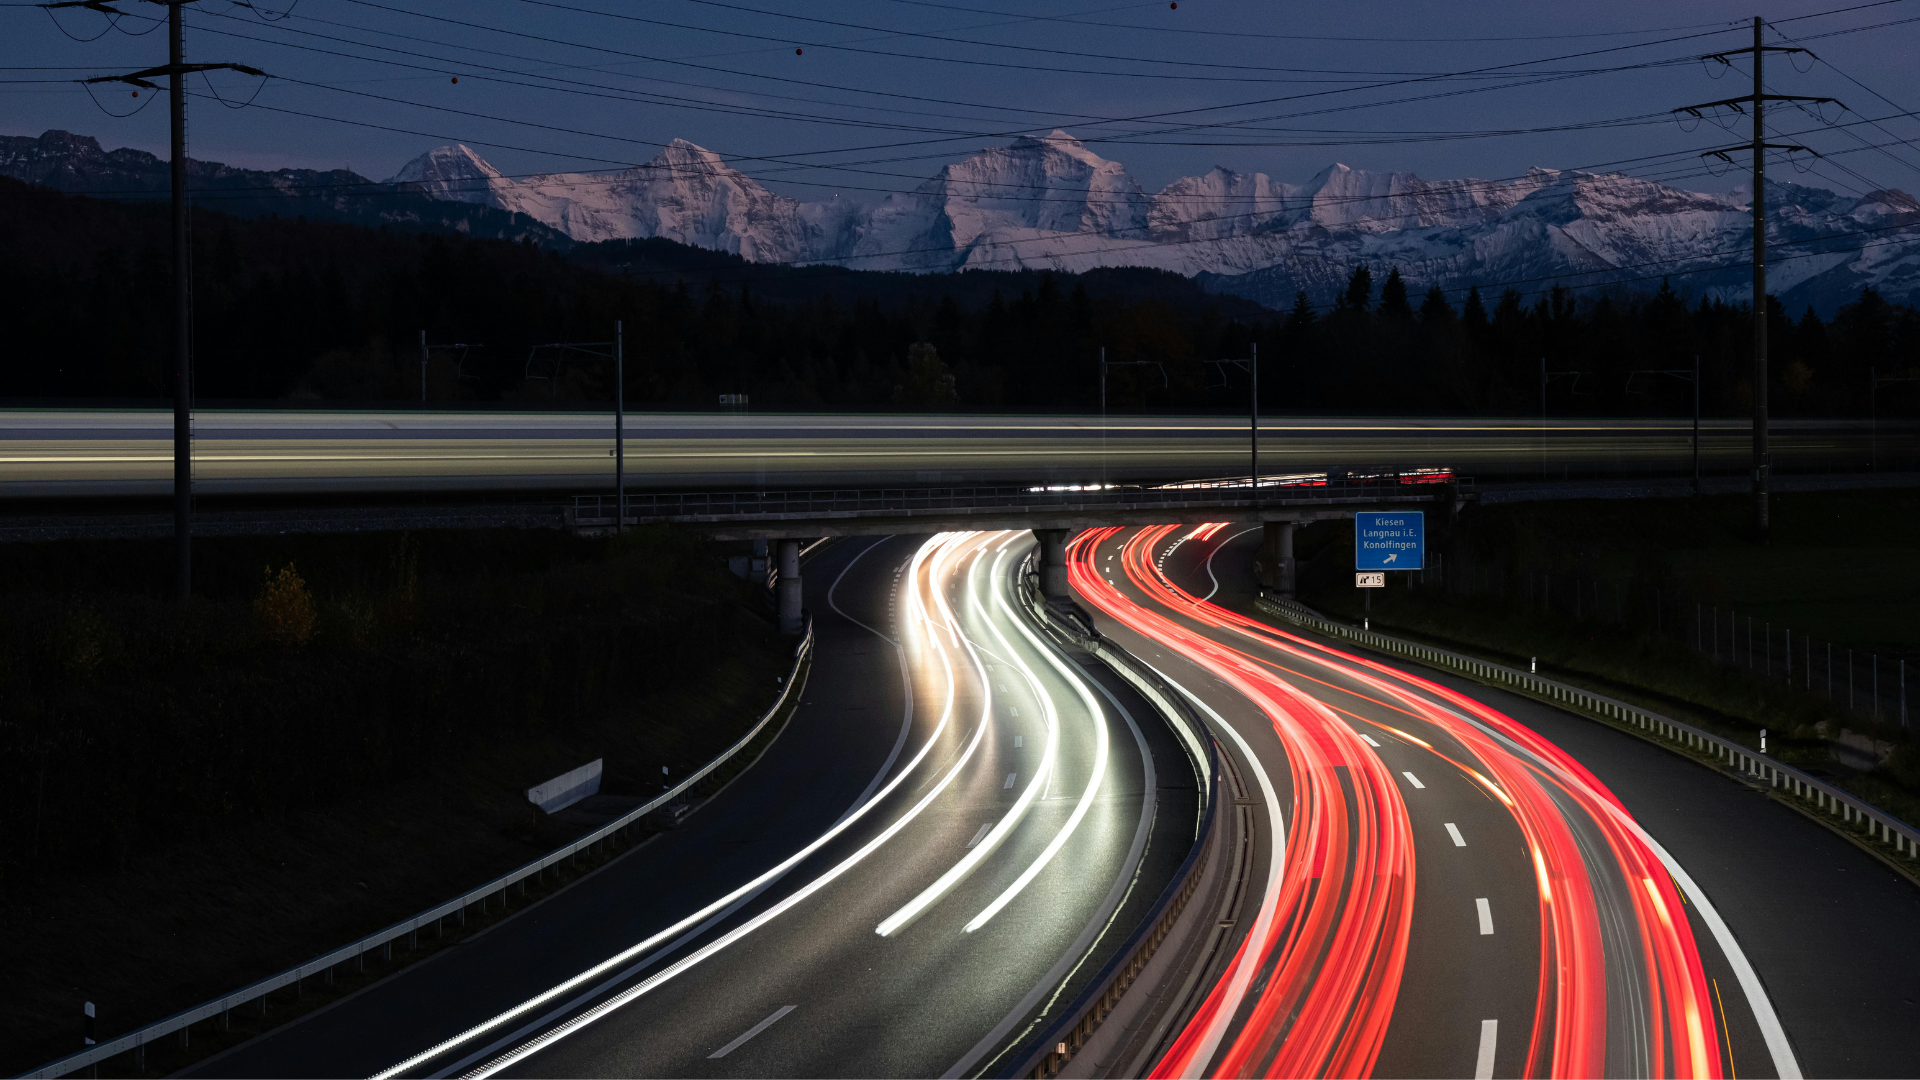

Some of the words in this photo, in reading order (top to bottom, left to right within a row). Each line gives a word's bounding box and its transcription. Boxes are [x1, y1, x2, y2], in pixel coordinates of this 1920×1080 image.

[1375, 518, 1404, 526] Kiesen
[1363, 529, 1400, 539] Langnau
[1403, 529, 1416, 537] i.E.
[1363, 541, 1416, 550] Konolfingen
